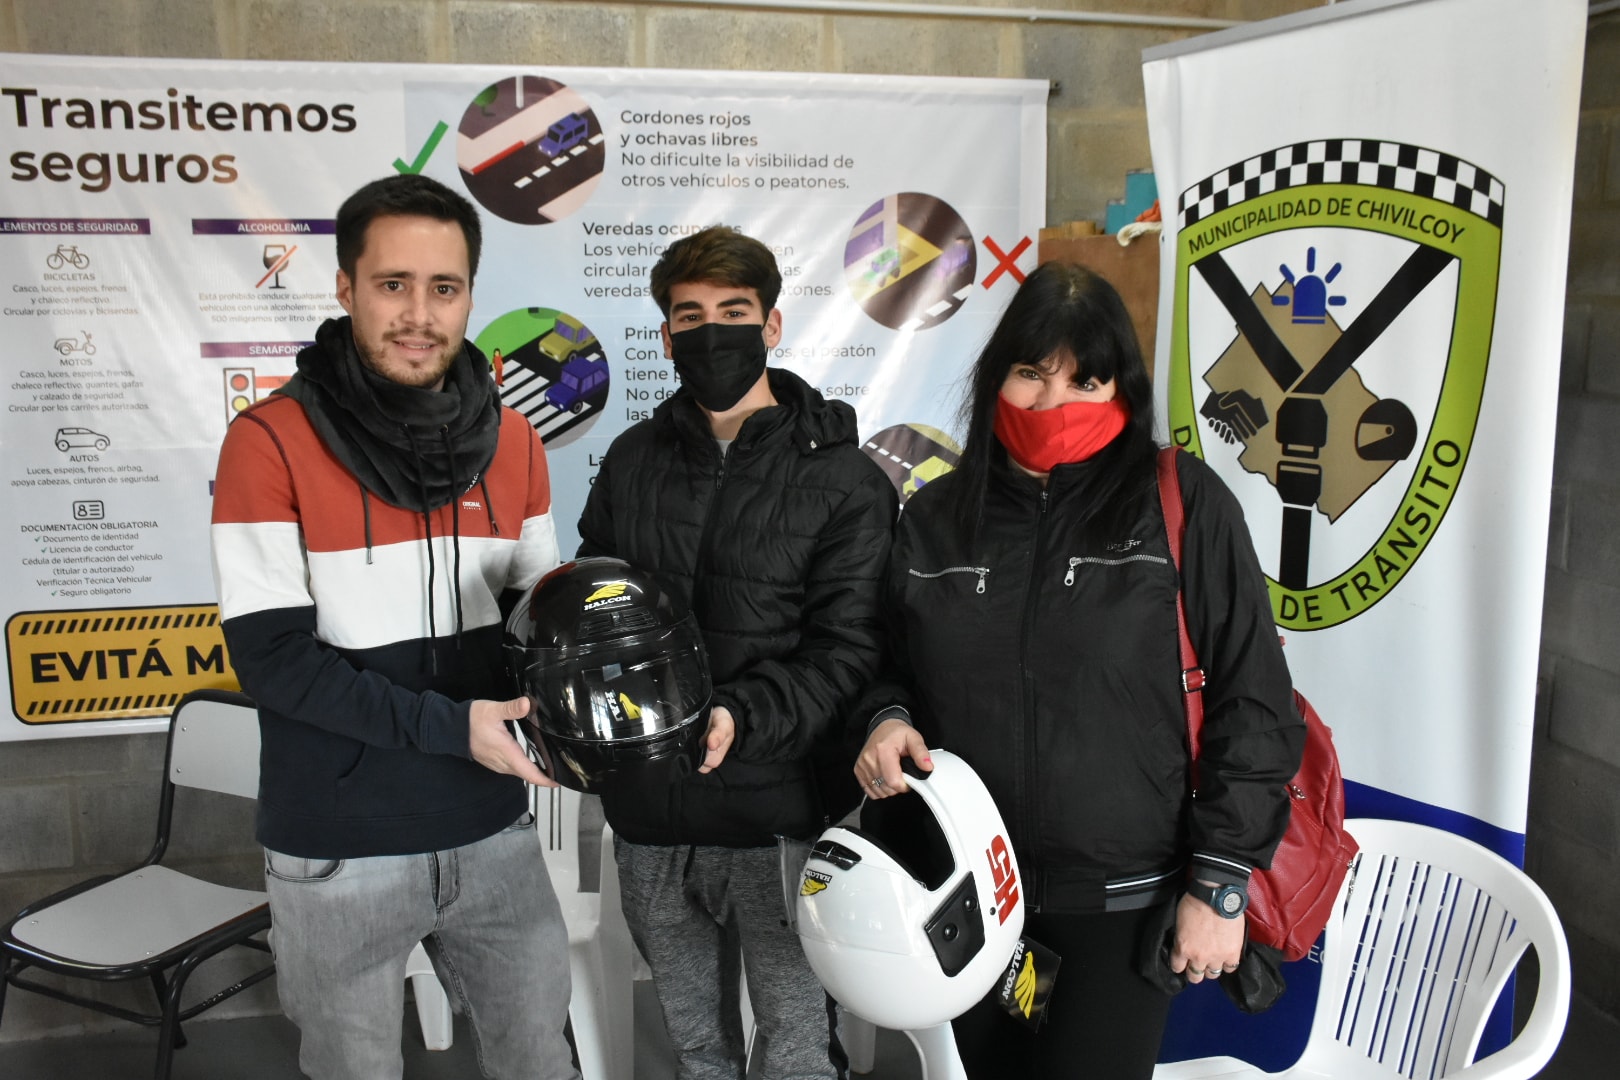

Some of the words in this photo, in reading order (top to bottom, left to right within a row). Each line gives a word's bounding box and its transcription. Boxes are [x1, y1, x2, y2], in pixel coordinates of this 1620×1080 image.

[1, 88, 358, 133] Transitemos
[620, 110, 704, 125] Cordones
[709, 111, 751, 129] rojos
[620, 134, 630, 148] y
[635, 131, 706, 146] ochavas
[712, 132, 758, 146] libres
[621, 152, 646, 166] No
[650, 152, 722, 167] dificulte
[727, 152, 740, 167] la
[745, 153, 829, 168] visibilidad
[833, 154, 854, 168] de
[10, 150, 239, 193] seguros
[621, 174, 665, 187] otros
[670, 173, 750, 188] vehículos
[754, 177, 765, 188] o
[770, 176, 849, 191] peatones.
[0, 222, 58, 232] LEMENTOS
[60, 222, 75, 232] DE
[77, 222, 139, 232] SEGURIDAD
[237, 223, 311, 233] ALCOHOLEMIA
[582, 221, 653, 236] Veredas
[1188, 198, 1322, 255] MUNICIPALIDAD
[1327, 198, 1353, 216] DE
[1356, 200, 1465, 245] CHIVILCOY
[584, 243, 613, 256] Los
[617, 242, 667, 256] vehíc
[43, 272, 96, 281] BICICLETAS
[584, 262, 648, 277] circular
[584, 283, 651, 297] veredas
[625, 347, 658, 361] Con
[59, 358, 93, 367] MOTOS
[625, 367, 668, 381] tiene
[626, 388, 650, 401] No
[826, 384, 870, 397] sobre
[626, 407, 649, 421] las
[69, 454, 100, 462] AUTOS
[20, 522, 99, 533] DOCUMENTACIÓN
[100, 520, 159, 530] OBLIGATORIA
[1280, 594, 1323, 622] DE
[1330, 439, 1461, 612] TRÁNSITO
[42, 535, 89, 543] Documento
[91, 533, 101, 541] de
[102, 532, 139, 541] identidad
[49, 545, 81, 554] Licencia
[83, 544, 94, 552] de
[95, 544, 134, 552] conductor
[51, 556, 62, 564] de
[117, 554, 129, 562] del
[89, 565, 135, 574] autorizado)
[116, 575, 152, 584] Vehicular
[59, 588, 88, 598] Seguro
[90, 587, 132, 597] obligatorio
[583, 595, 632, 611] HALCON
[30, 638, 173, 684] EVITÁ
[185, 644, 225, 675] M
